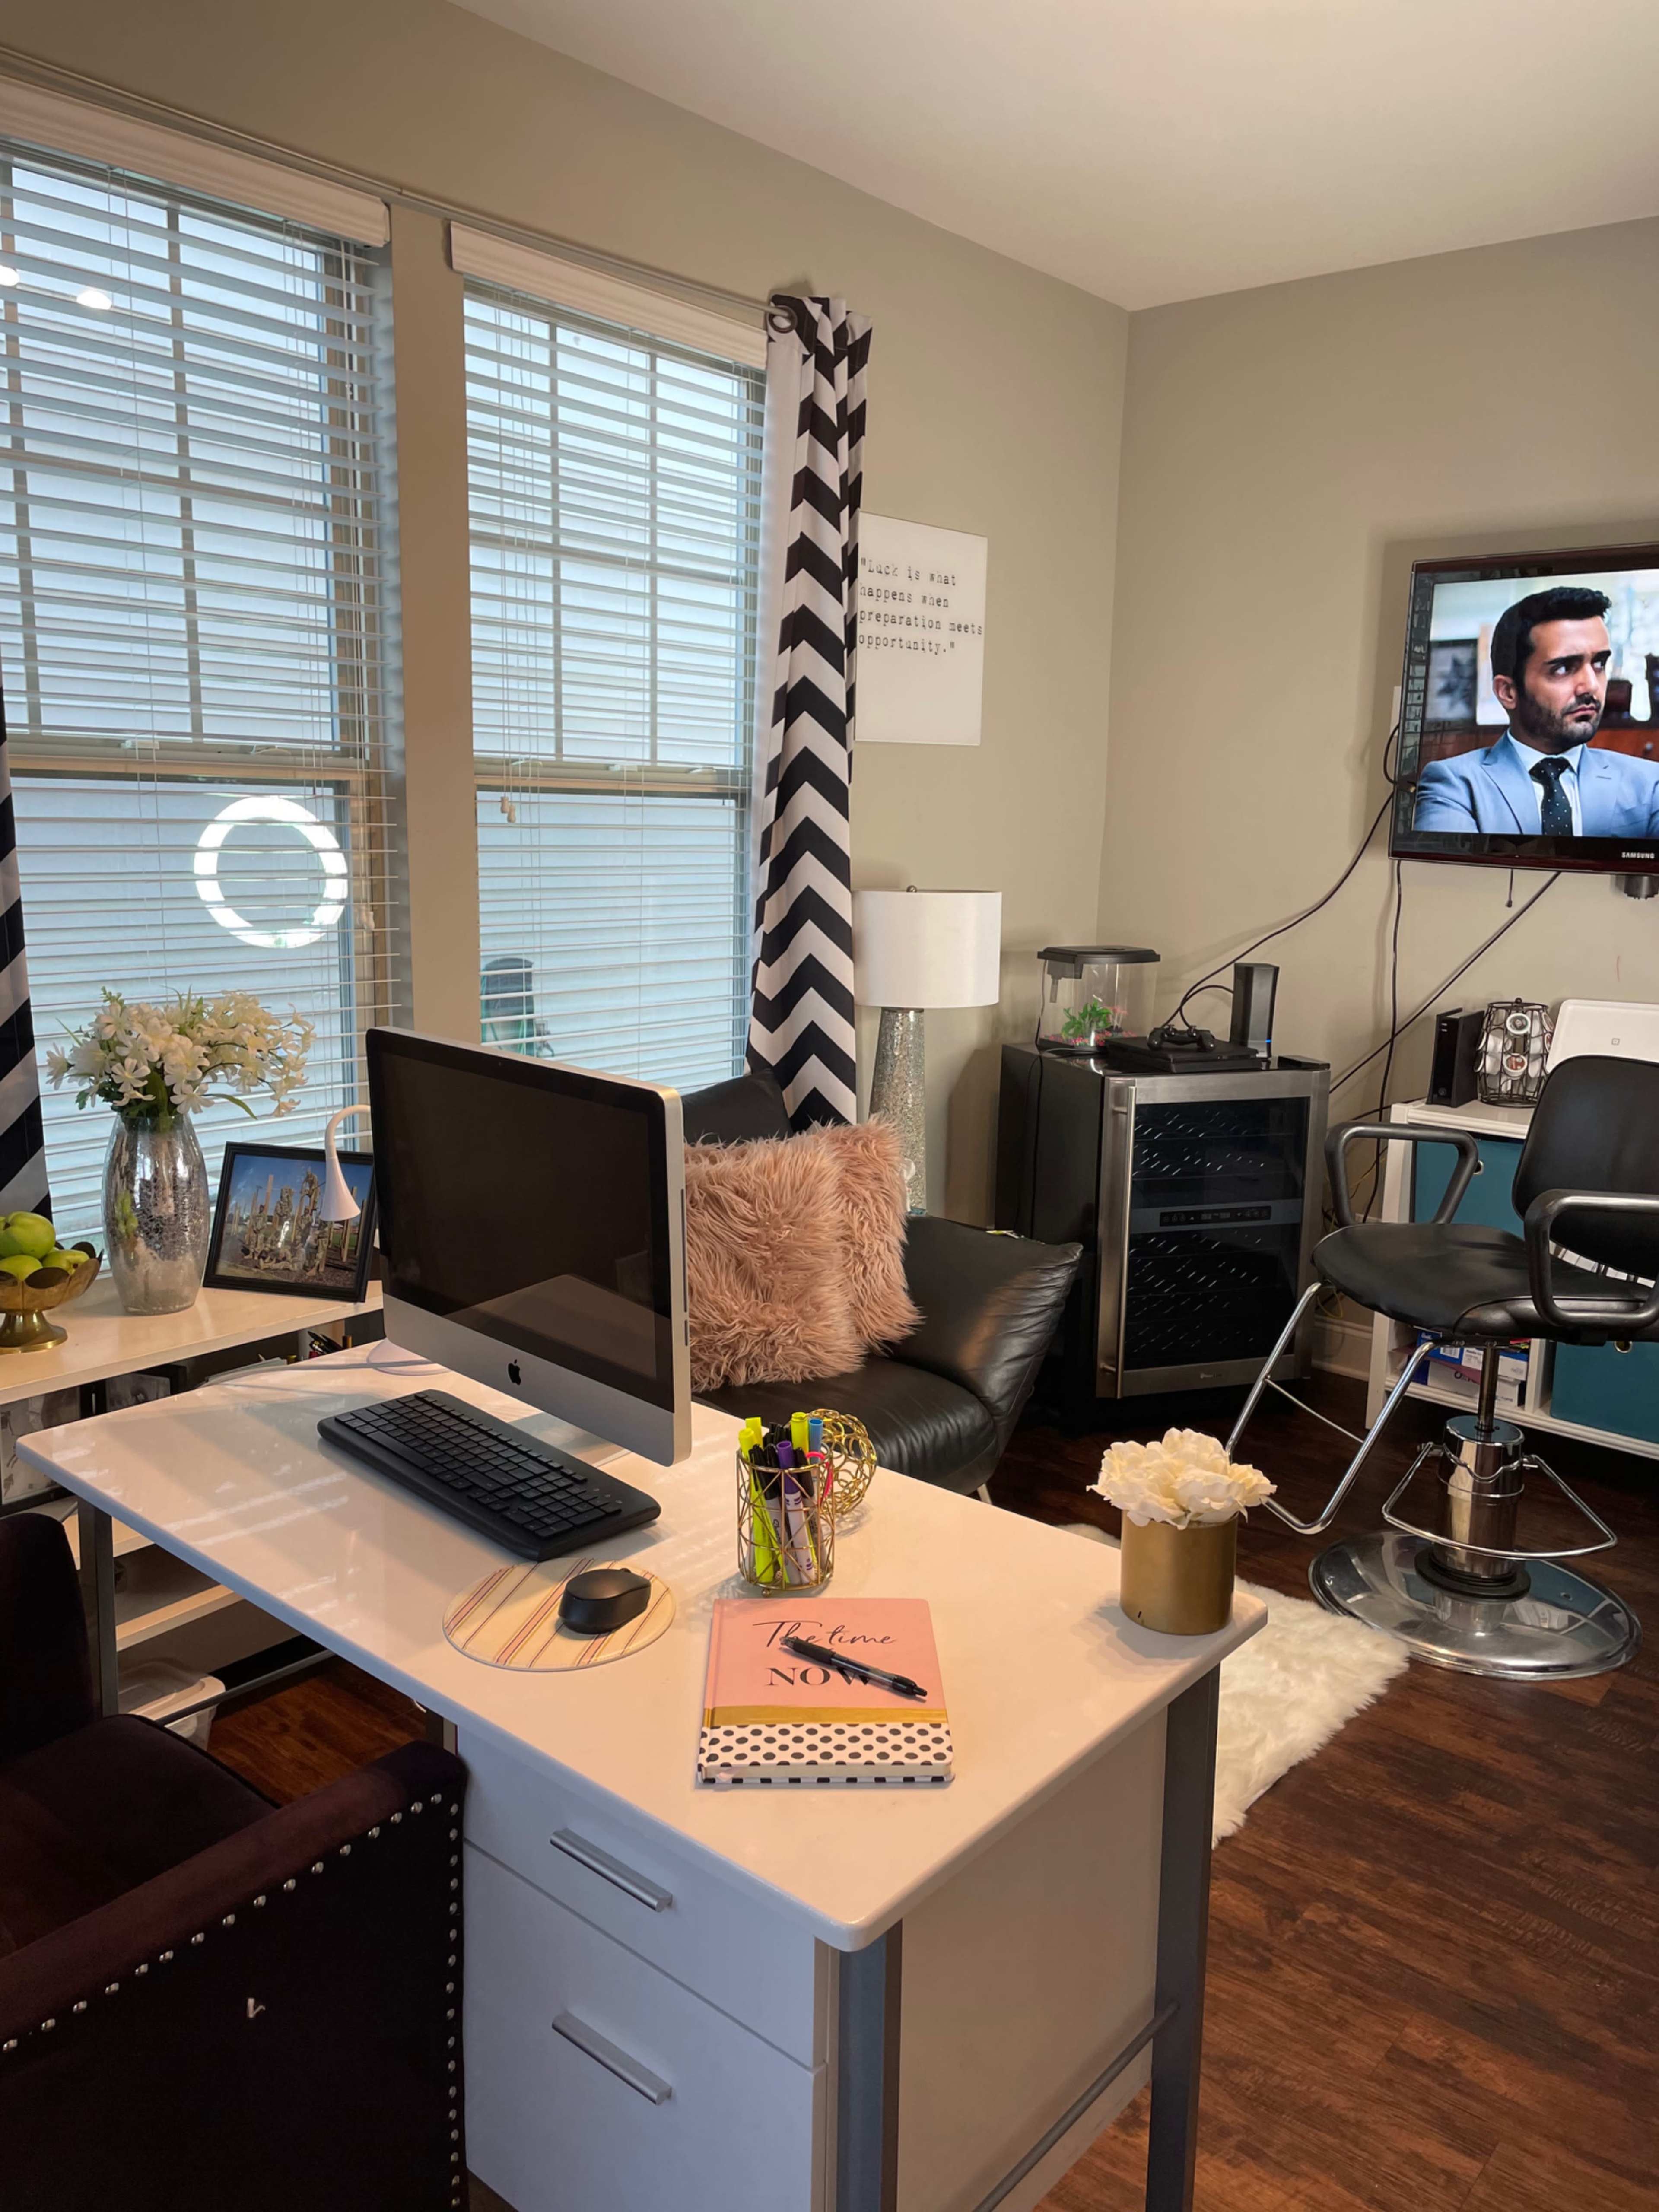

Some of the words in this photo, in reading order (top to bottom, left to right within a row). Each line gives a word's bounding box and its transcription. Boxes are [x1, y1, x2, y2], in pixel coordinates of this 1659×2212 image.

[861, 557, 898, 577] "Luck
[907, 566, 920, 581] is
[930, 571, 956, 586] what
[860, 582, 912, 603] happens
[922, 594, 949, 608] when
[859, 610, 941, 630] preparation
[949, 621, 982, 635] meets
[753, 1620, 823, 1647] The
[826, 1625, 896, 1644] time
